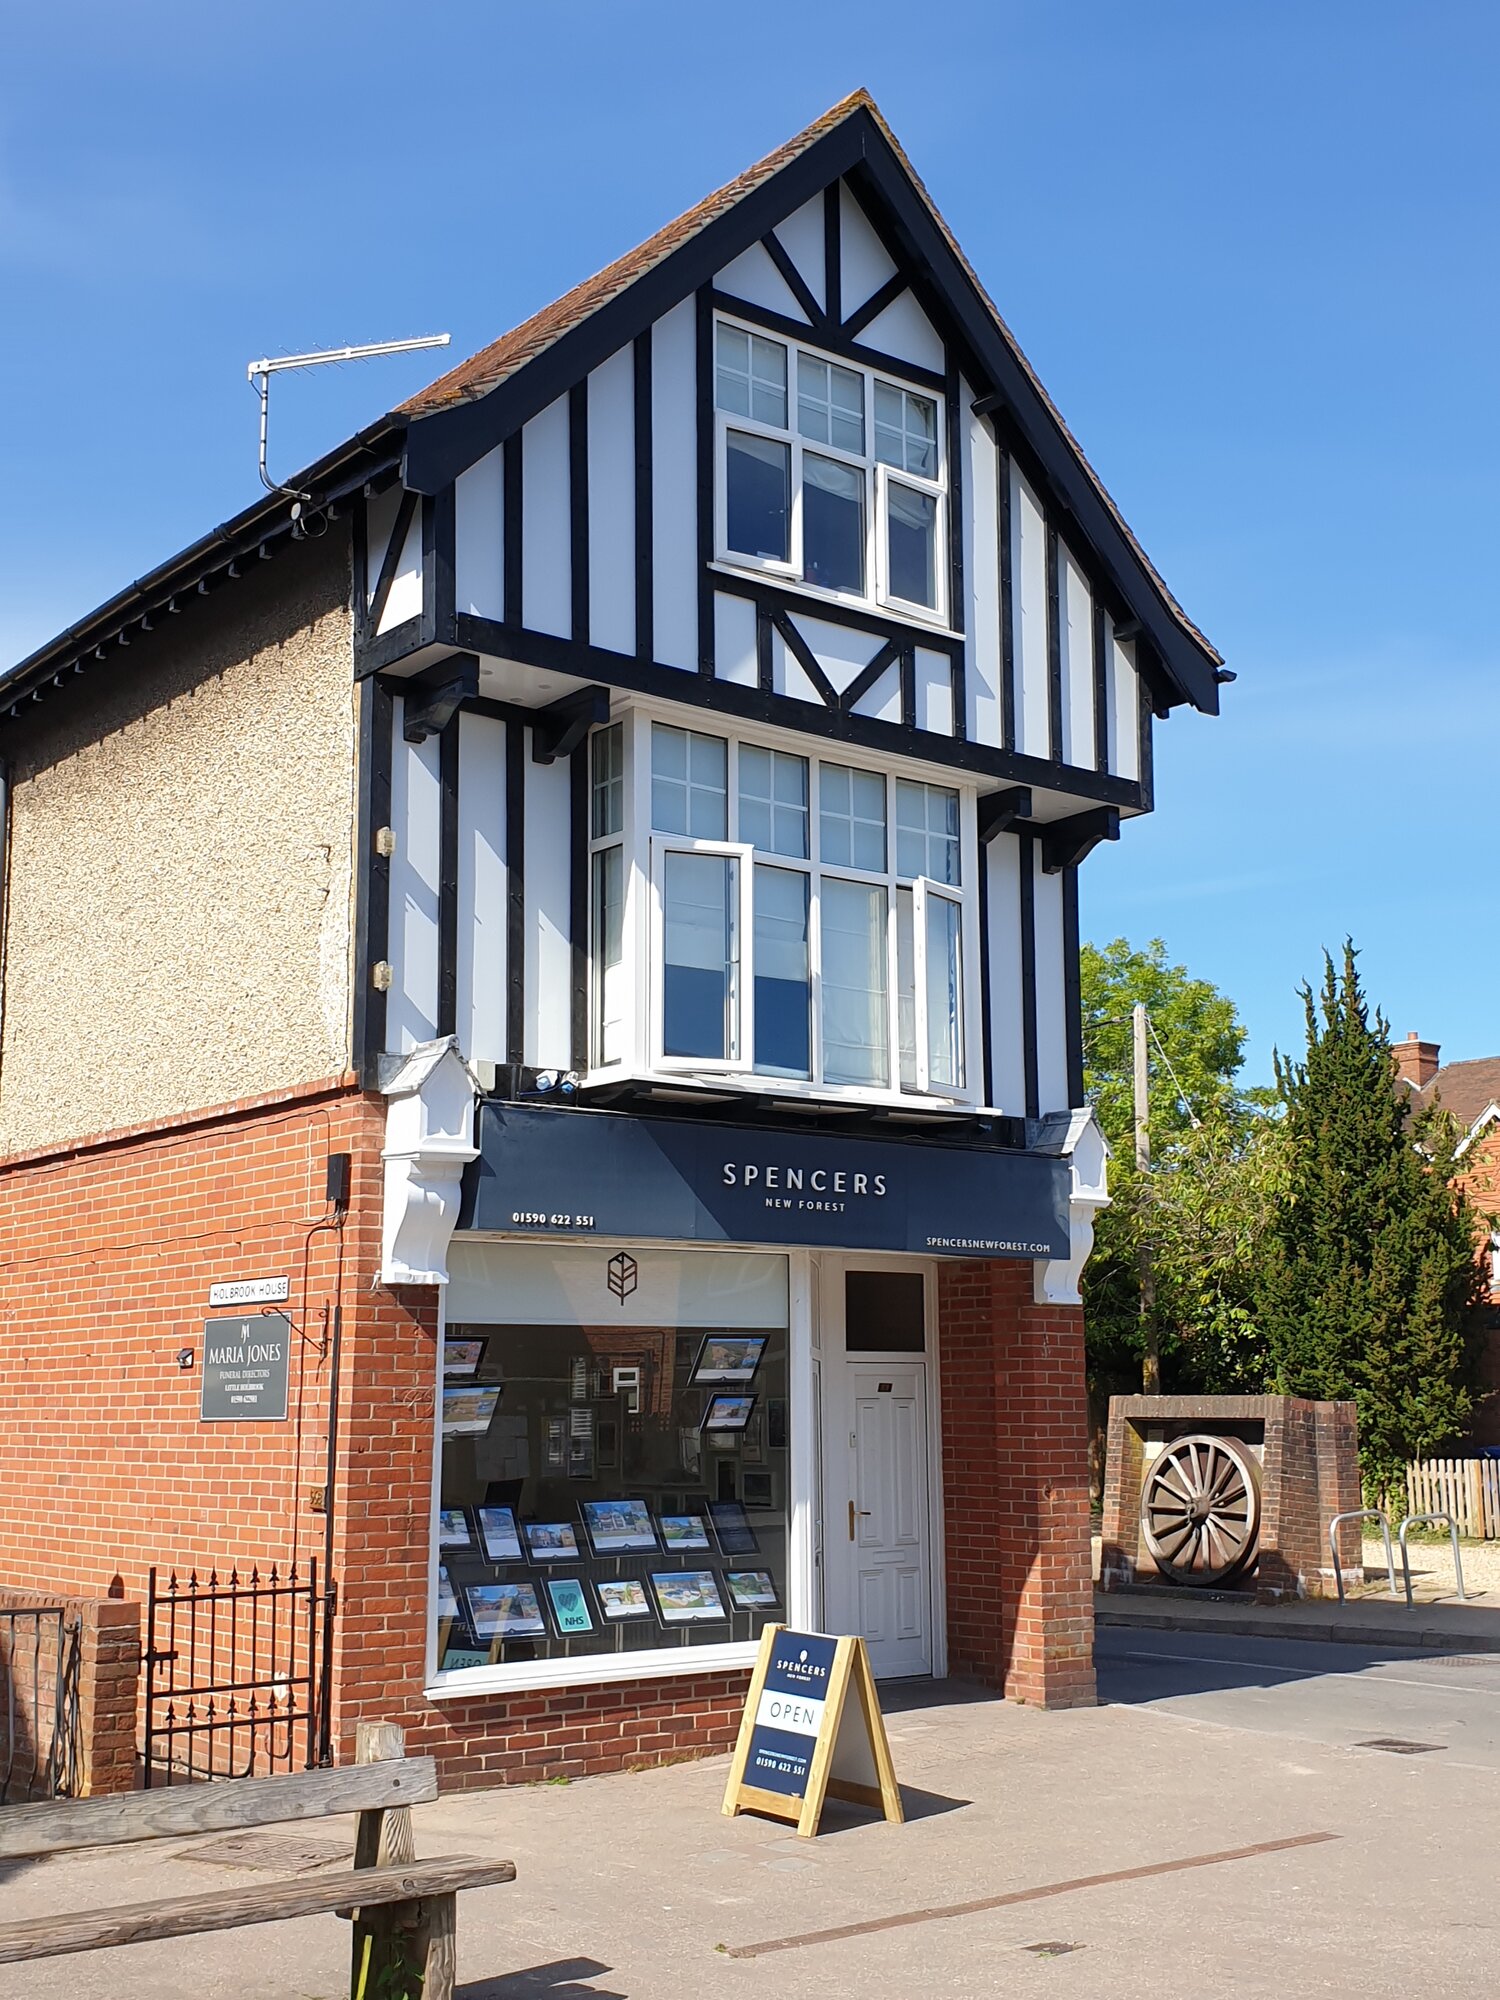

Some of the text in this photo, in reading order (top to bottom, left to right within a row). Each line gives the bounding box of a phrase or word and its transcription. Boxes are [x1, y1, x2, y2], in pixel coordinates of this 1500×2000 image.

[723, 1163, 887, 1196] SPENCERS
[765, 1198, 846, 1212] NEW FOREST
[512, 1212, 594, 1226] 01590 622 551
[926, 1237, 1051, 1253] SPENCERSNEWFOREST.COM
[213, 1281, 287, 1300] HOLBROOK HOUSE
[208, 1343, 281, 1366] MARIA JONES
[565, 1616, 584, 1626] NHS
[776, 1660, 826, 1677] SPENCERS
[770, 1702, 815, 1725] OPEN
[756, 1756, 777, 1769] 01590
[778, 1762, 791, 1773] 622
[793, 1765, 805, 1776] 551
